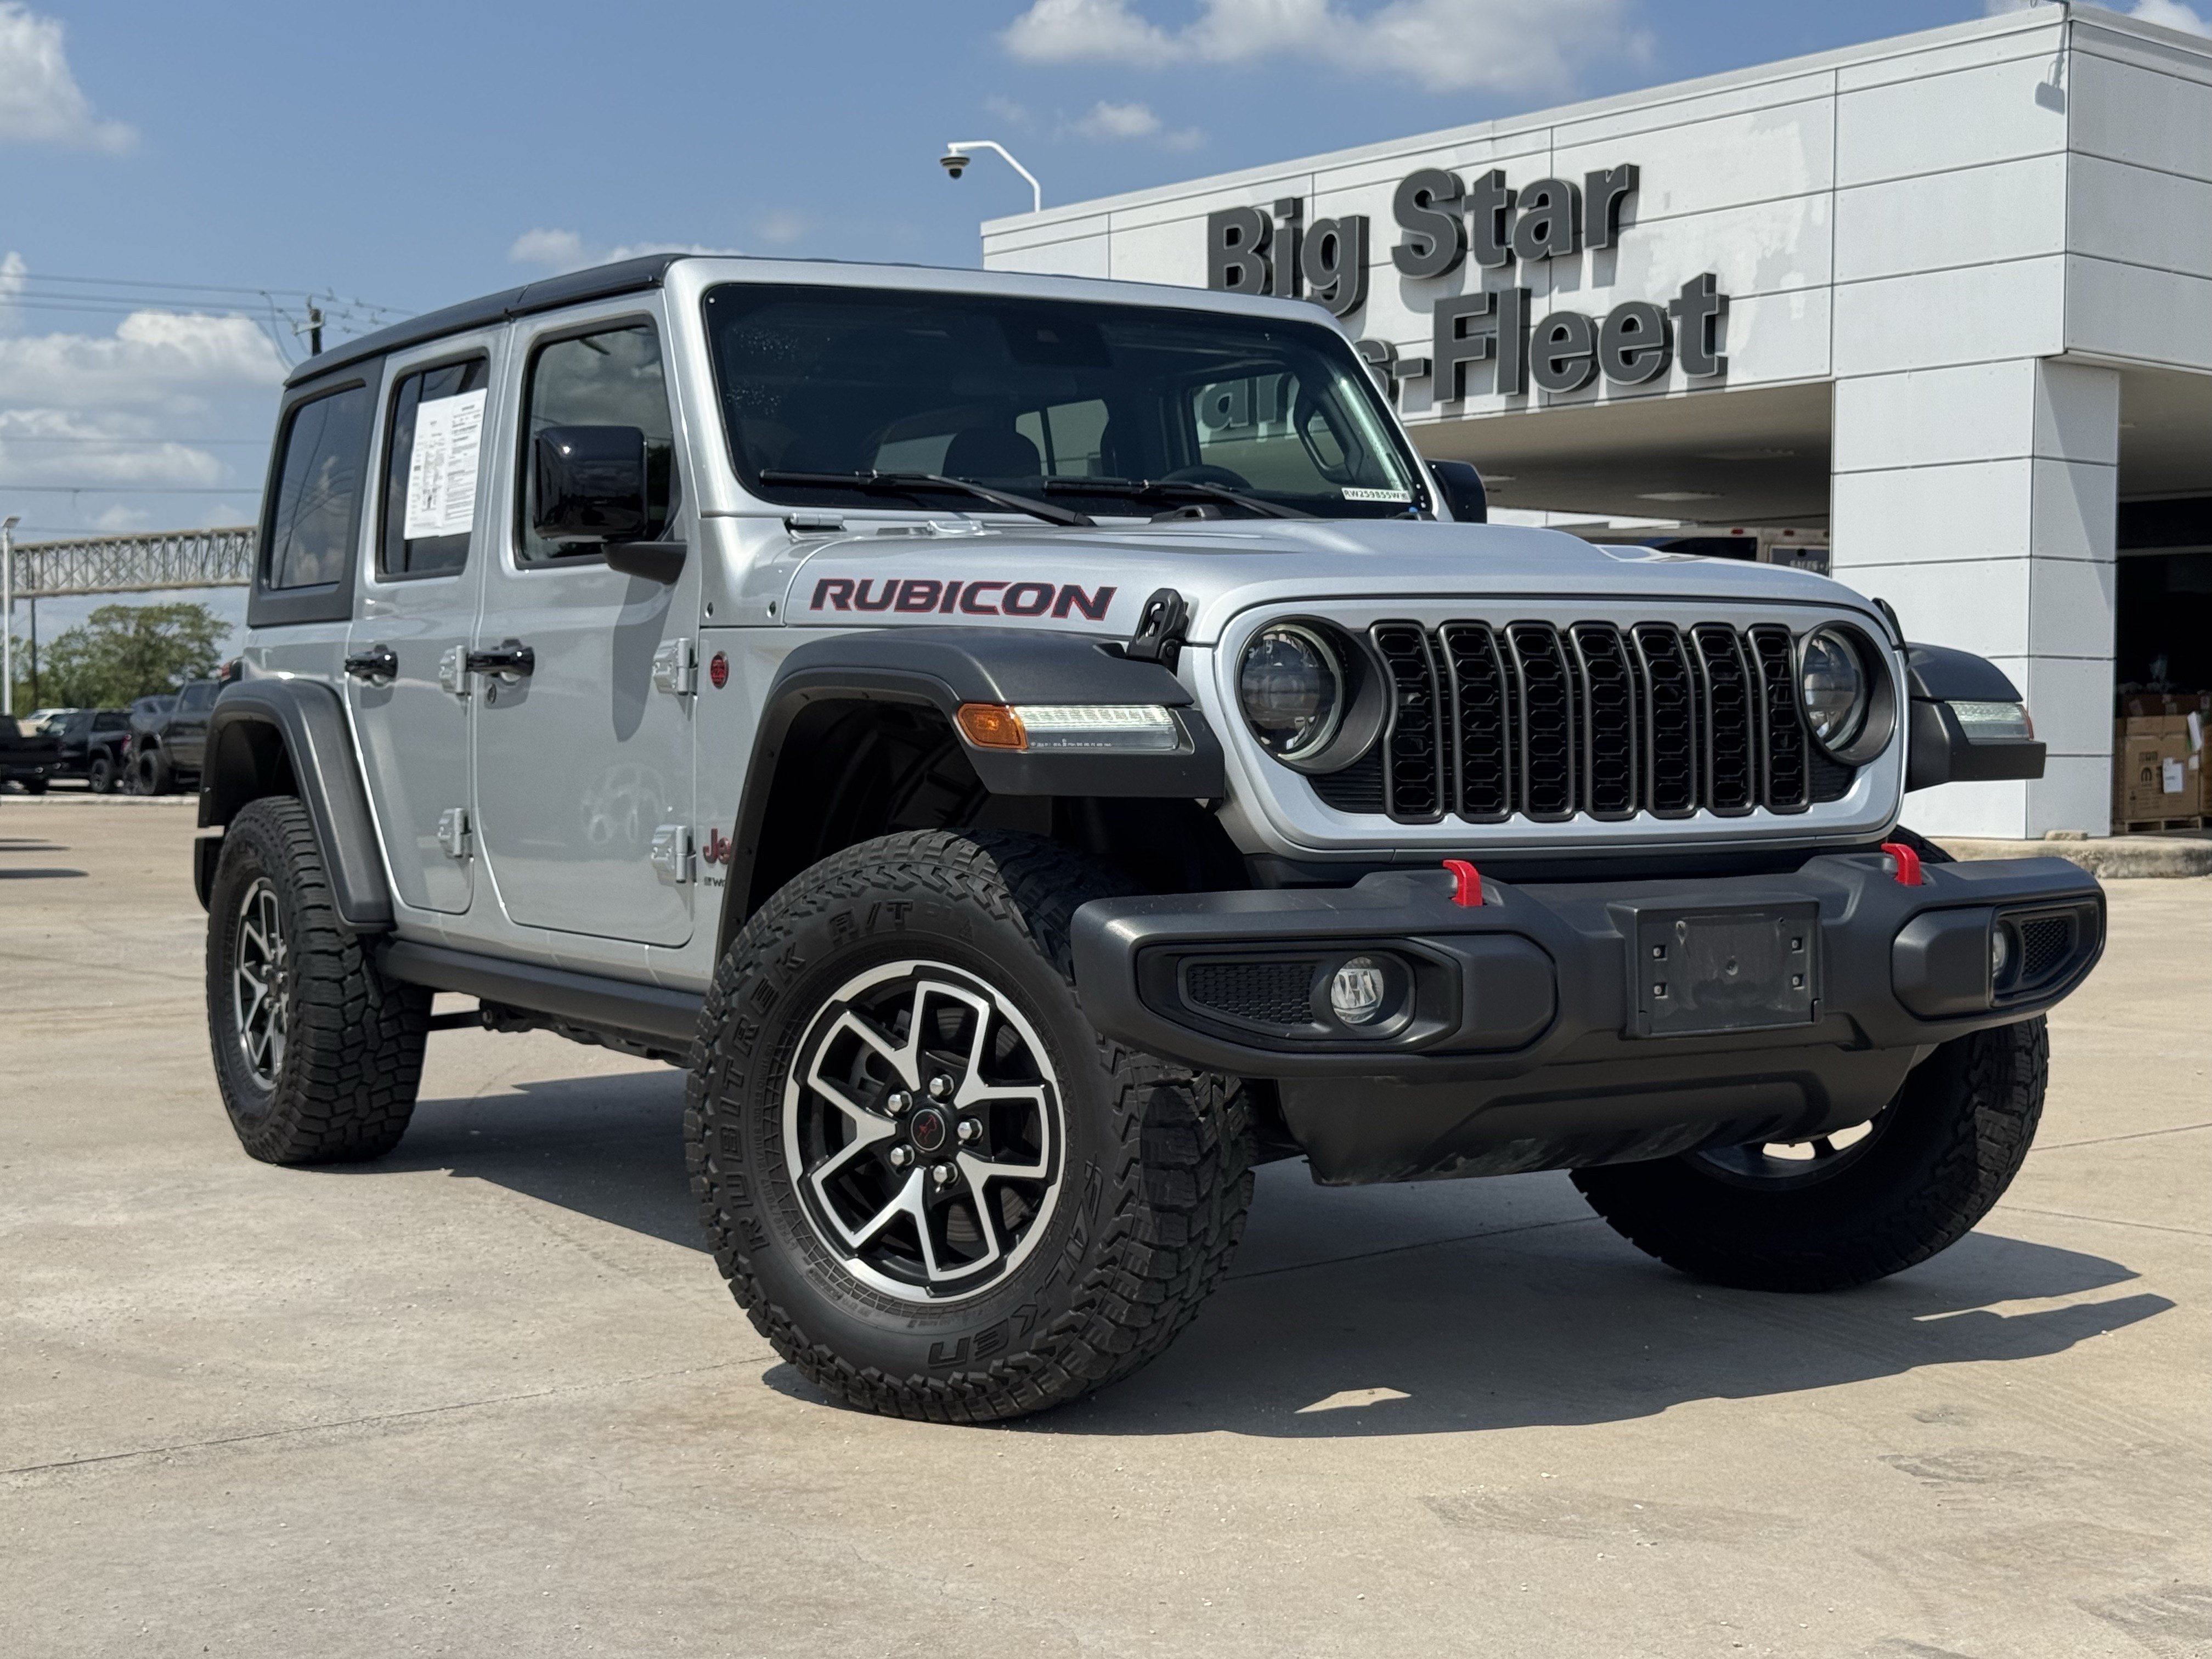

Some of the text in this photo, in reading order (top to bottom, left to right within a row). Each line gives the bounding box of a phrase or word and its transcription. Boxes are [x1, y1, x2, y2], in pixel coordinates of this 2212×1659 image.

[1207, 163, 1639, 317] Big Star
[809, 578, 1118, 622] RUBICON
[702, 828, 732, 865] Je
[718, 940, 807, 1253] RUBITREK
[927, 1154, 1104, 1370] FALKEN
